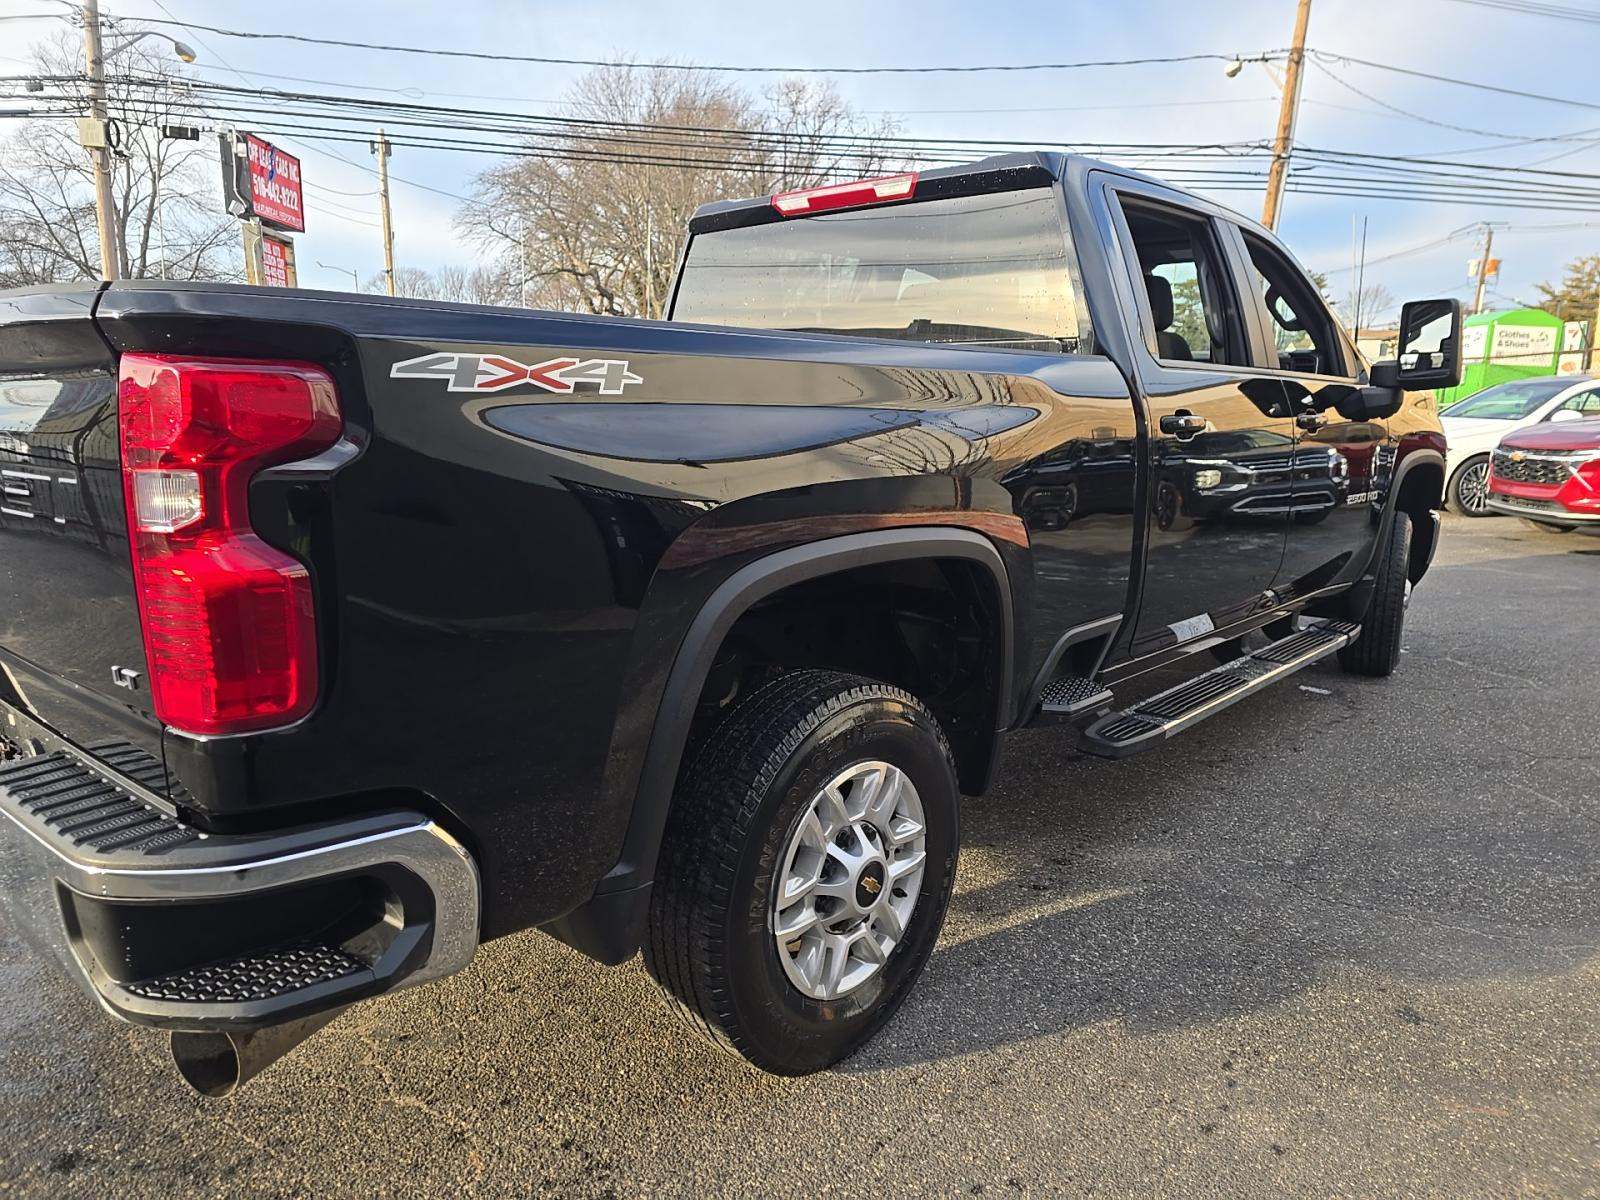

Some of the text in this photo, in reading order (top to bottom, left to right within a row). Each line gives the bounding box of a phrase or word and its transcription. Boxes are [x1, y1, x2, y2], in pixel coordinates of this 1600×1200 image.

[1499, 330, 1530, 339] Clothes
[1505, 340, 1529, 348] Shoes
[110, 665, 139, 690] LT
